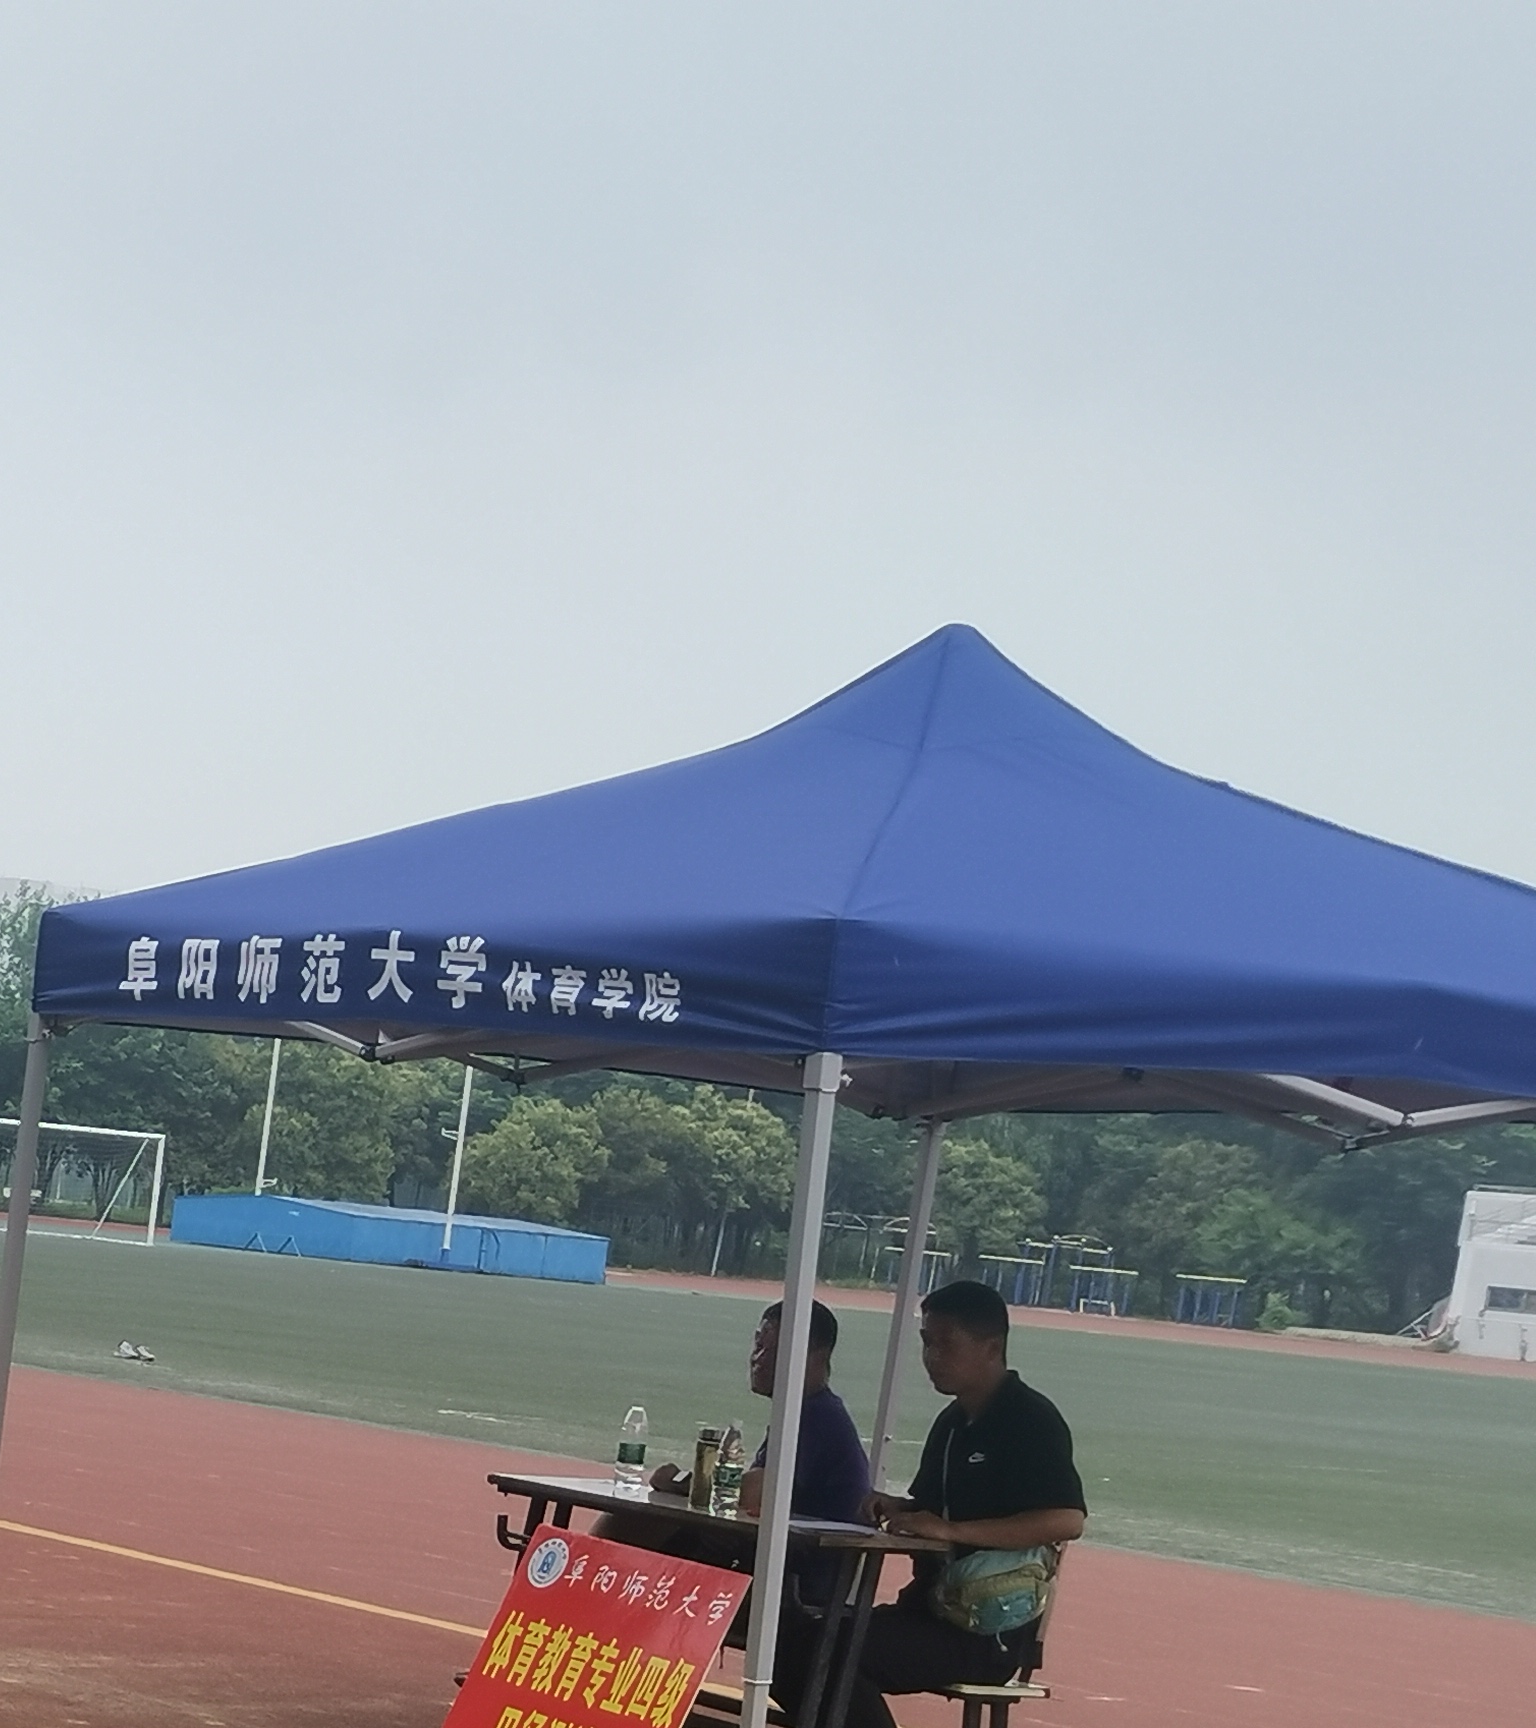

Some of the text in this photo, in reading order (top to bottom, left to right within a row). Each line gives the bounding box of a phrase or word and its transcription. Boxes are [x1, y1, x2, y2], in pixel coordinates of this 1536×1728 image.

[119, 930, 682, 1023] 阜阳师范大学 体育学院
[563, 1553, 734, 1627] 阜阳师范大学
